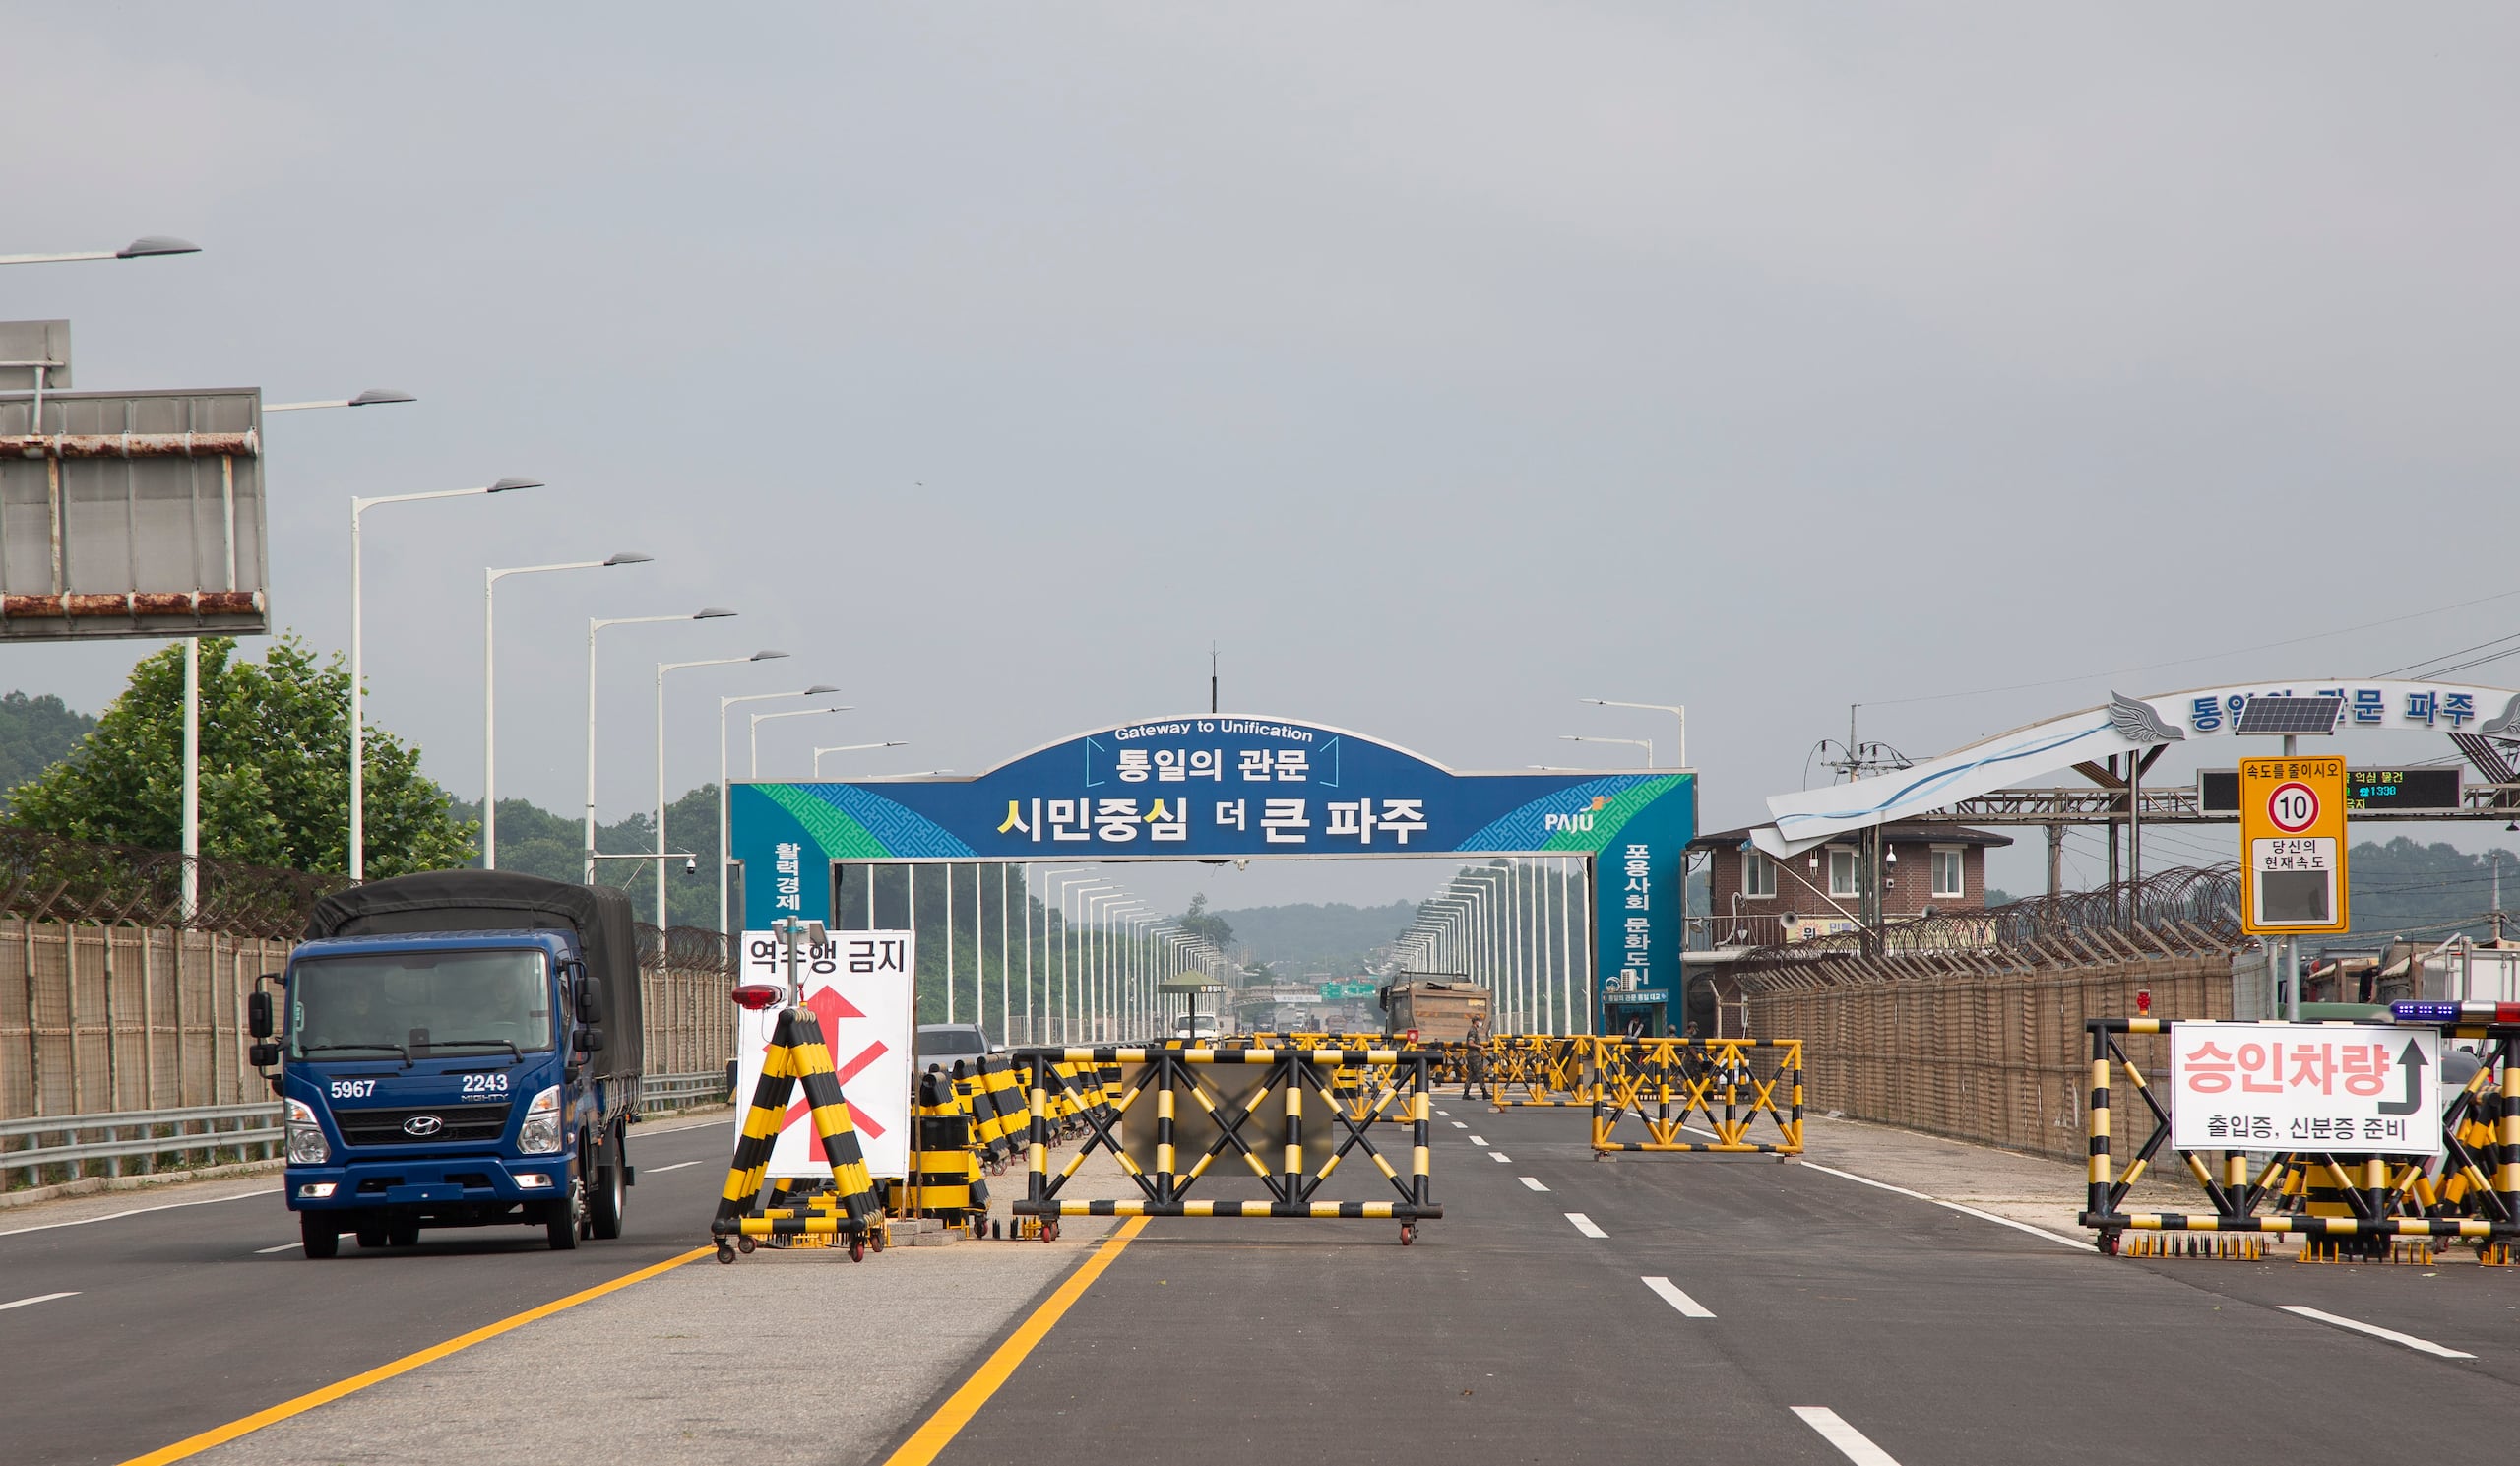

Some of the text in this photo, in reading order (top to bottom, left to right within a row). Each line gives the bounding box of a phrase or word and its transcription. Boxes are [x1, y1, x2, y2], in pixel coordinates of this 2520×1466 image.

[2406, 690, 2475, 727] 파주
[1114, 720, 1314, 743] Gateway to Unification
[1115, 748, 1310, 783] 통일의 관문
[2247, 762, 2338, 780] 속도를 줄이시오
[2279, 796, 2307, 819] 10
[996, 797, 1428, 845] 시민중심 더 큰 파주
[1545, 813, 1594, 833] PAJU
[2272, 839, 2316, 855] 당신의
[2264, 856, 2325, 870] 현재속도
[774, 842, 801, 912] 활력경제
[1623, 844, 1651, 911] 포용사회
[849, 940, 905, 973] 금지
[2184, 1041, 2390, 1096] 승인차량
[331, 1079, 376, 1099] 5967
[462, 1073, 508, 1092] 2243
[461, 1093, 510, 1102] MIGHTY
[2207, 1115, 2407, 1142] 출입증, 신분증 준비
